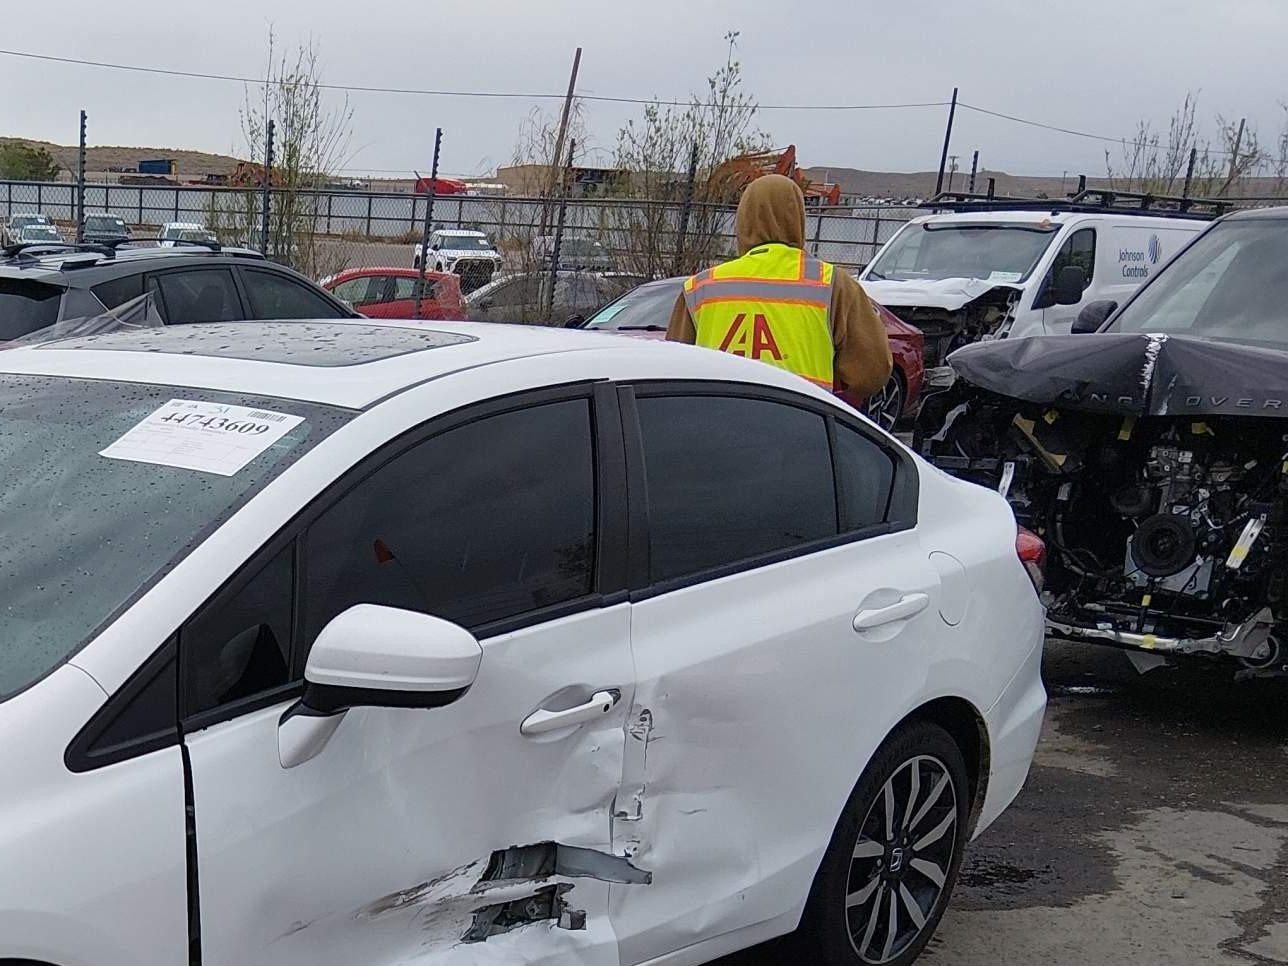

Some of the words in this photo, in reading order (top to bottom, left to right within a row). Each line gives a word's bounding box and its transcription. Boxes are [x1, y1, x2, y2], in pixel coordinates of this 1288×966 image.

[1118, 248, 1145, 262] Johnson
[1122, 264, 1149, 278] Controls
[1185, 396, 1282, 409] OVER
[160, 411, 270, 436] 44743609
